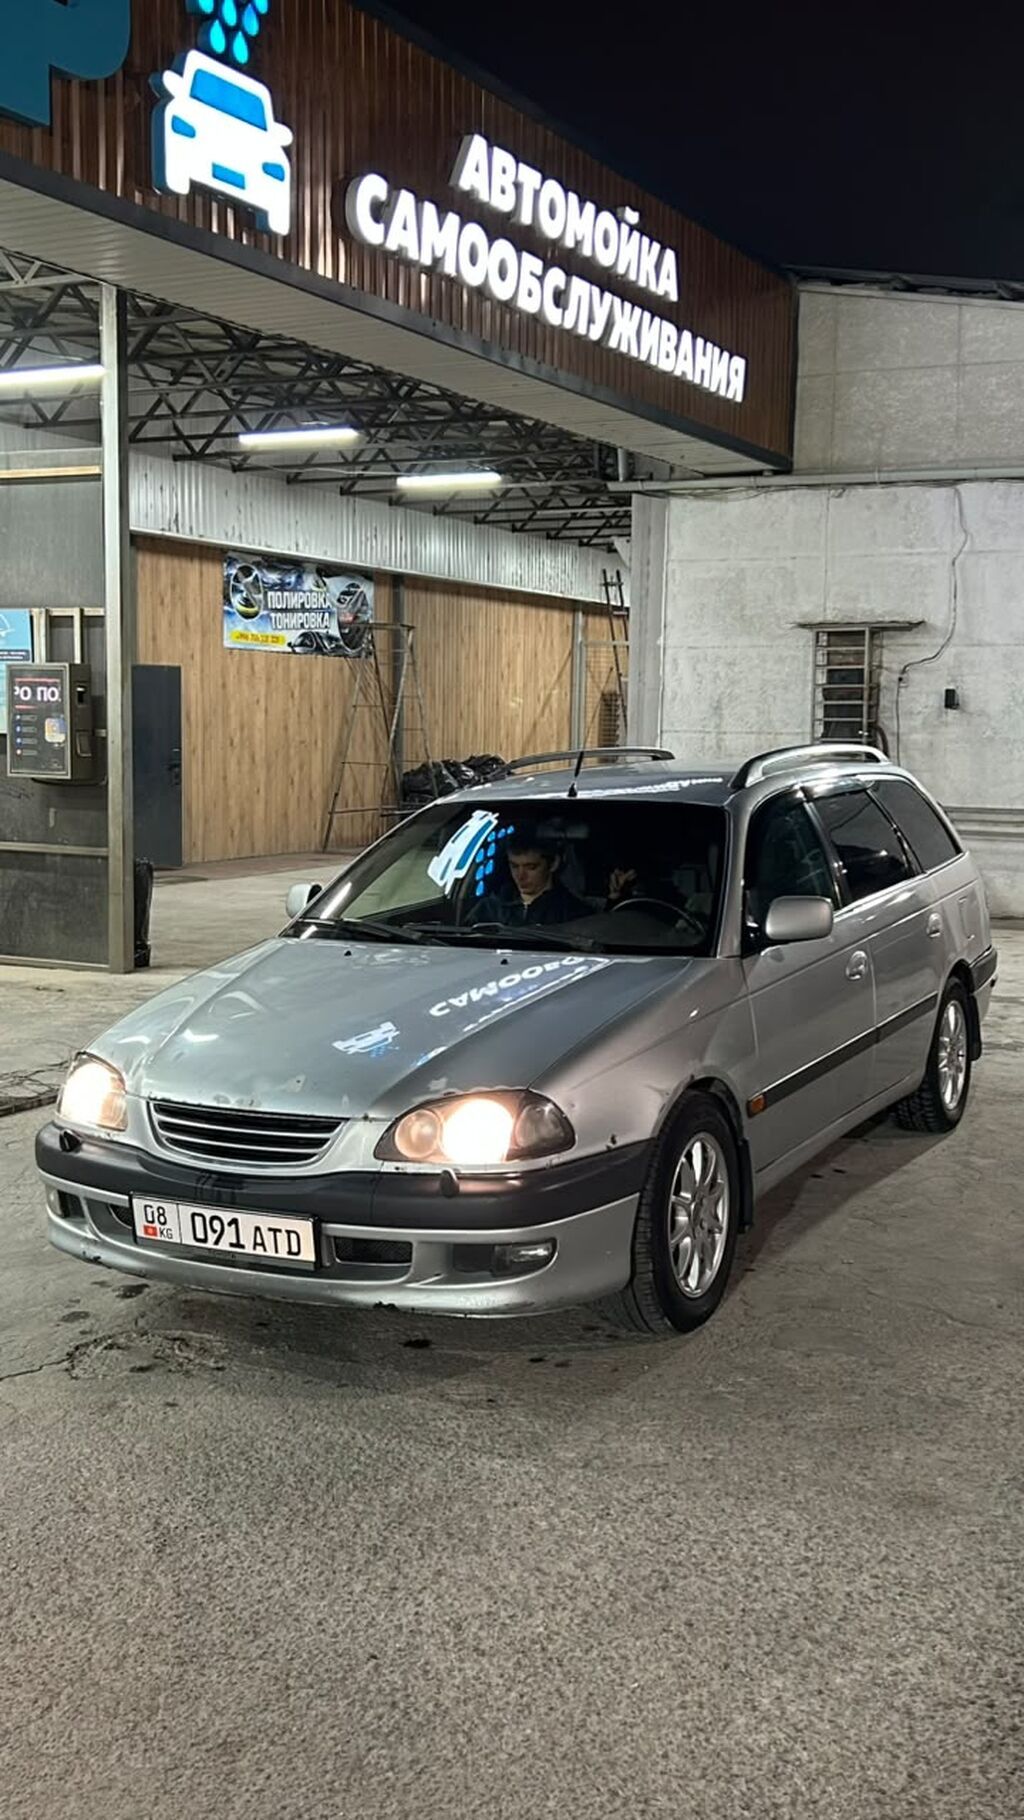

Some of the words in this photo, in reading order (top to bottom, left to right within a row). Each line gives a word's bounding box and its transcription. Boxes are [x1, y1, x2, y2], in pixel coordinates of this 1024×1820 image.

[456, 133, 679, 302] АВТОМОЙКА
[353, 172, 747, 402] САМООБСЛУЖИВАНИЯ
[267, 591, 332, 610] ПОЛИРОВКА
[270, 611, 330, 630] ТОНИРОВКА
[36, 686, 61, 702] ПО
[143, 1204, 168, 1226] 08
[159, 1229, 173, 1240] KG
[191, 1212, 245, 1249] 091
[252, 1225, 301, 1256] ATD
